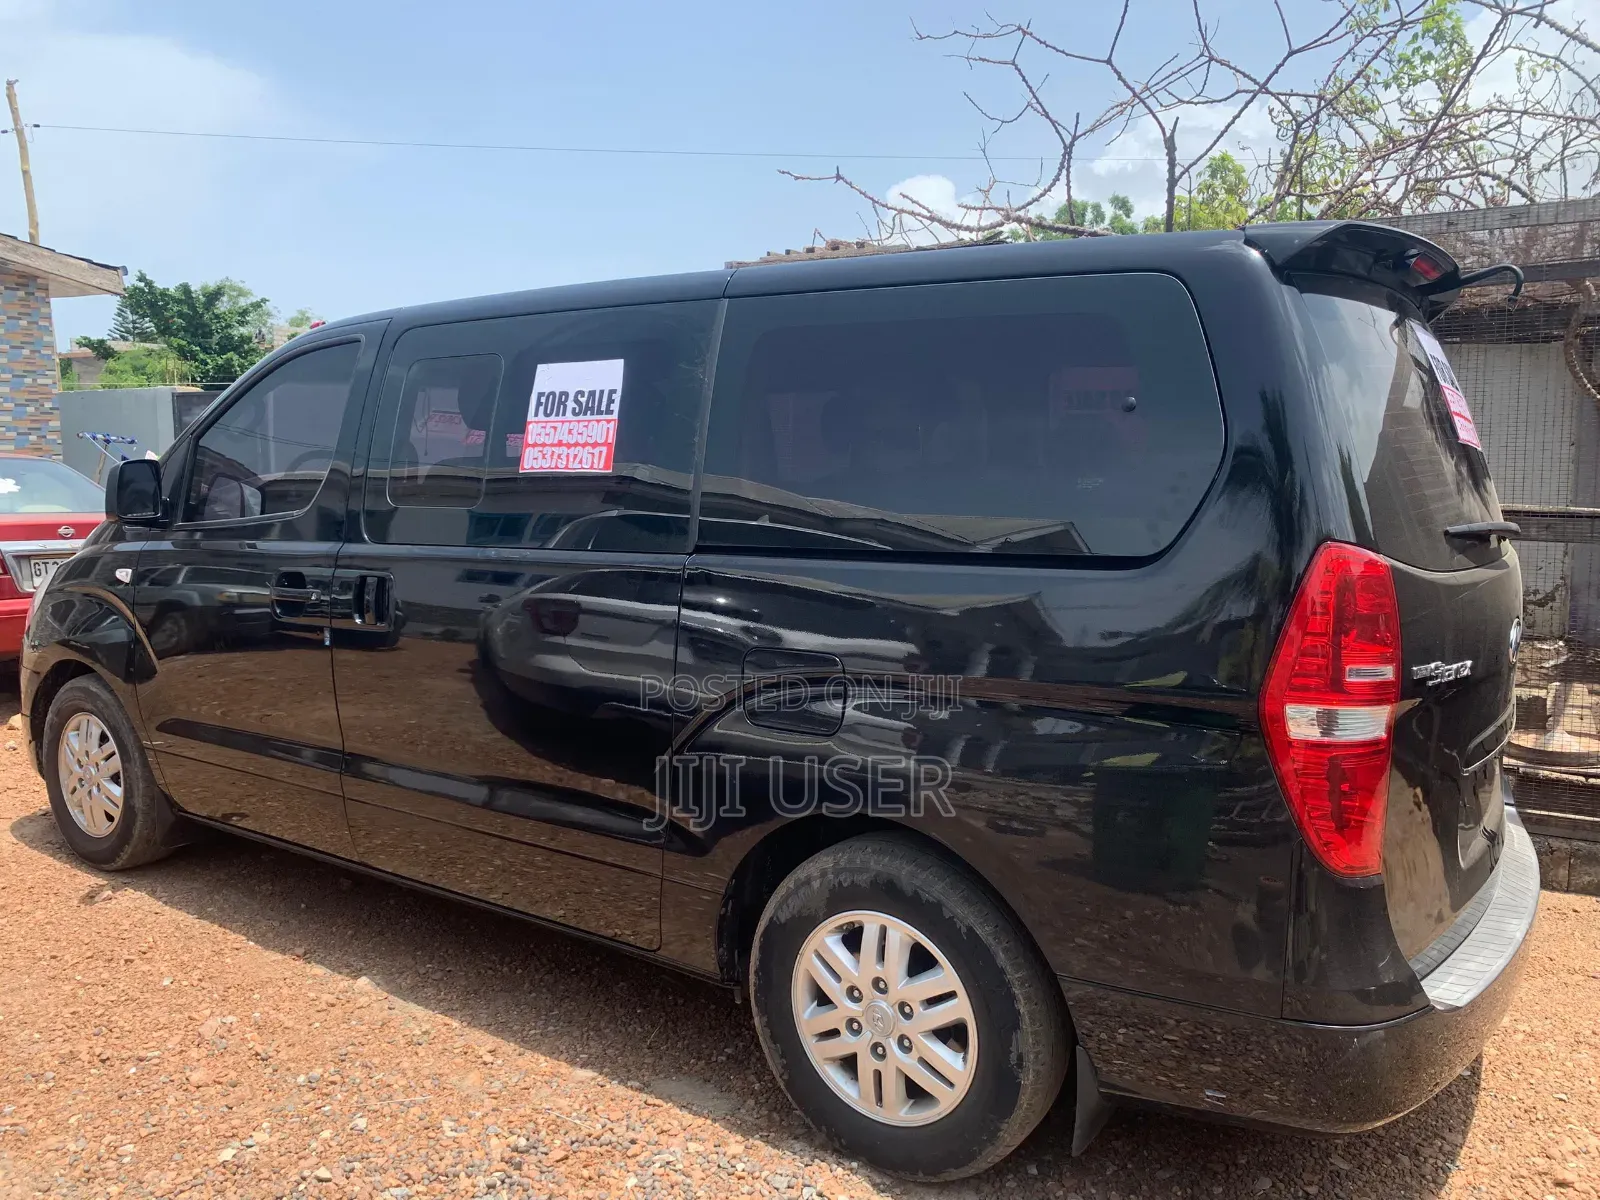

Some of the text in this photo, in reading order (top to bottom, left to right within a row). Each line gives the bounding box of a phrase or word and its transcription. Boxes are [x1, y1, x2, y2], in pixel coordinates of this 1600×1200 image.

[533, 388, 617, 418] FOR SALE
[528, 420, 615, 445] 0557435901
